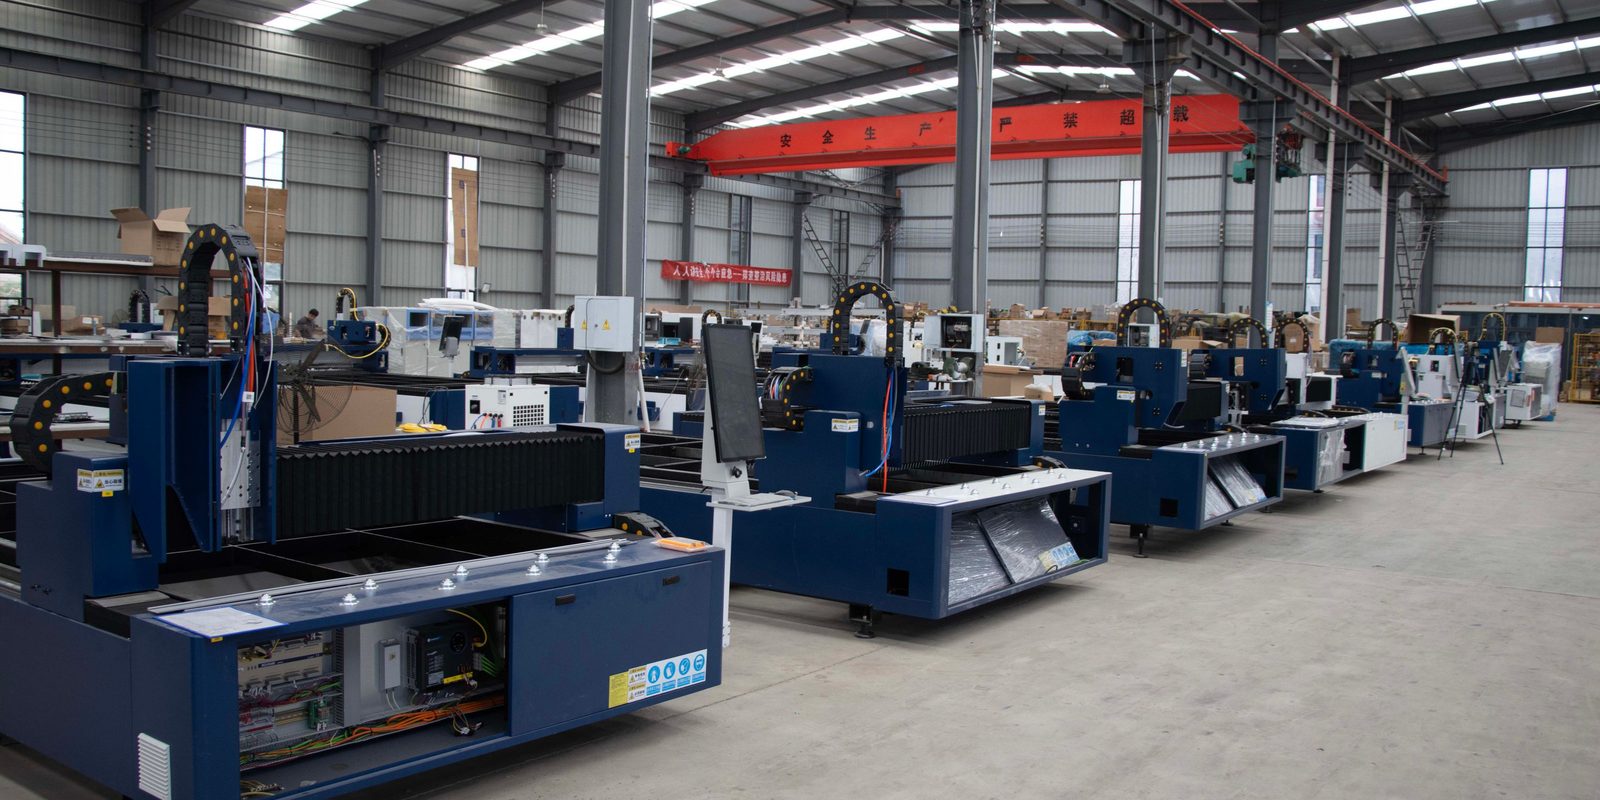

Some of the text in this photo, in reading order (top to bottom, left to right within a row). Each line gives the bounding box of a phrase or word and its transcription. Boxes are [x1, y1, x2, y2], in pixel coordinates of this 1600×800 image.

[780, 105, 1190, 148] 安全生产 严禁超载
